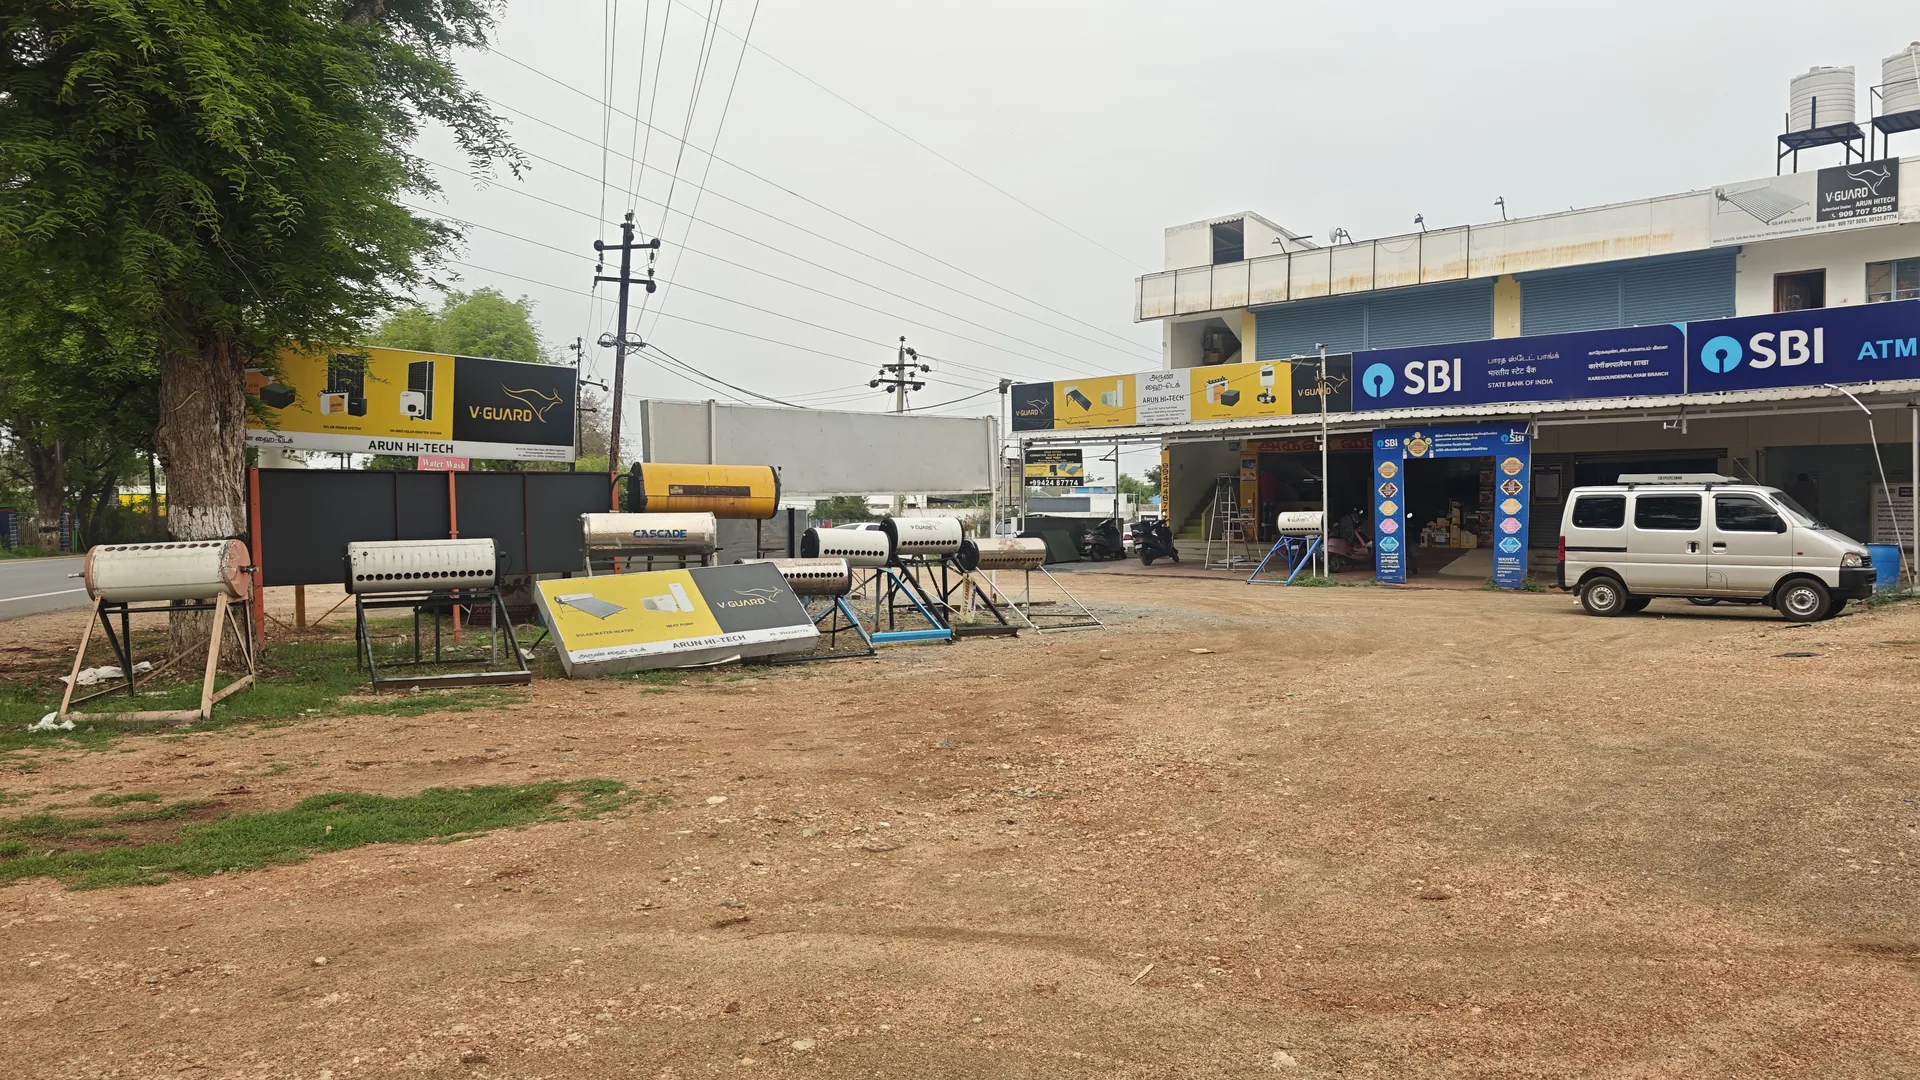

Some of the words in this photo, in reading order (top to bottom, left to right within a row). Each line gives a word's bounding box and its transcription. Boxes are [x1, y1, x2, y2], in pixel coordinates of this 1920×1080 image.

[1825, 187, 1868, 203] V-GUARD
[1855, 199, 1873, 208] ARUN
[1874, 196, 1895, 205] HITECH
[1838, 210, 1853, 218] 909
[1855, 208, 1870, 216] 707
[1872, 205, 1892, 213] 5055
[1749, 327, 1824, 369] SBI
[1857, 337, 1917, 361] ATM
[1149, 371, 1174, 383] அருண்
[1404, 357, 1461, 395] SBI
[1487, 381, 1506, 389] STATE
[1507, 380, 1524, 388] BANK
[1524, 379, 1534, 387] OF
[1535, 378, 1553, 386] INDIA
[1142, 396, 1159, 404] ARUN
[1160, 394, 1184, 402] HI-TECH
[469, 405, 532, 423] V-GUARD
[1384, 438, 1398, 447] SBI
[1509, 433, 1524, 442] SBI
[368, 440, 403, 452] ARUN
[407, 442, 454, 454] HI-TECH
[422, 459, 443, 469] Water
[446, 460, 466, 470] Wash
[633, 529, 687, 538] CASCADE
[716, 598, 766, 609] V-GUARD
[672, 639, 703, 650] ARUN
[704, 634, 746, 646] HI-TECH
